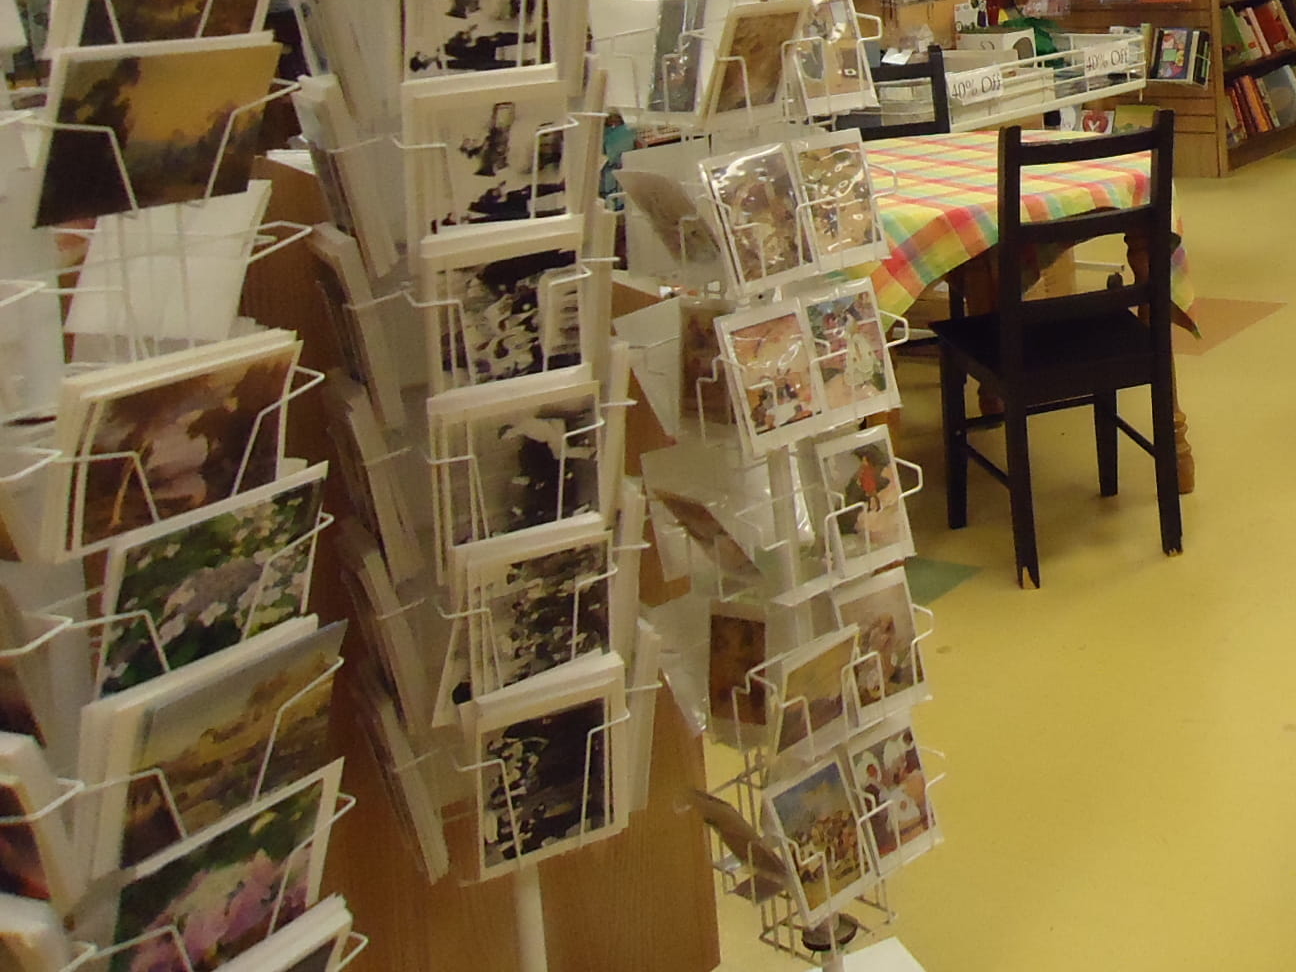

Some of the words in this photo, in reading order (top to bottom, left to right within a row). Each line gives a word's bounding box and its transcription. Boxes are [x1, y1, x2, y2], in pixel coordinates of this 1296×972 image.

[1085, 52, 1110, 73] 40%
[1110, 48, 1130, 66] Off
[950, 79, 979, 101] 40%
[980, 73, 1003, 95] Off
